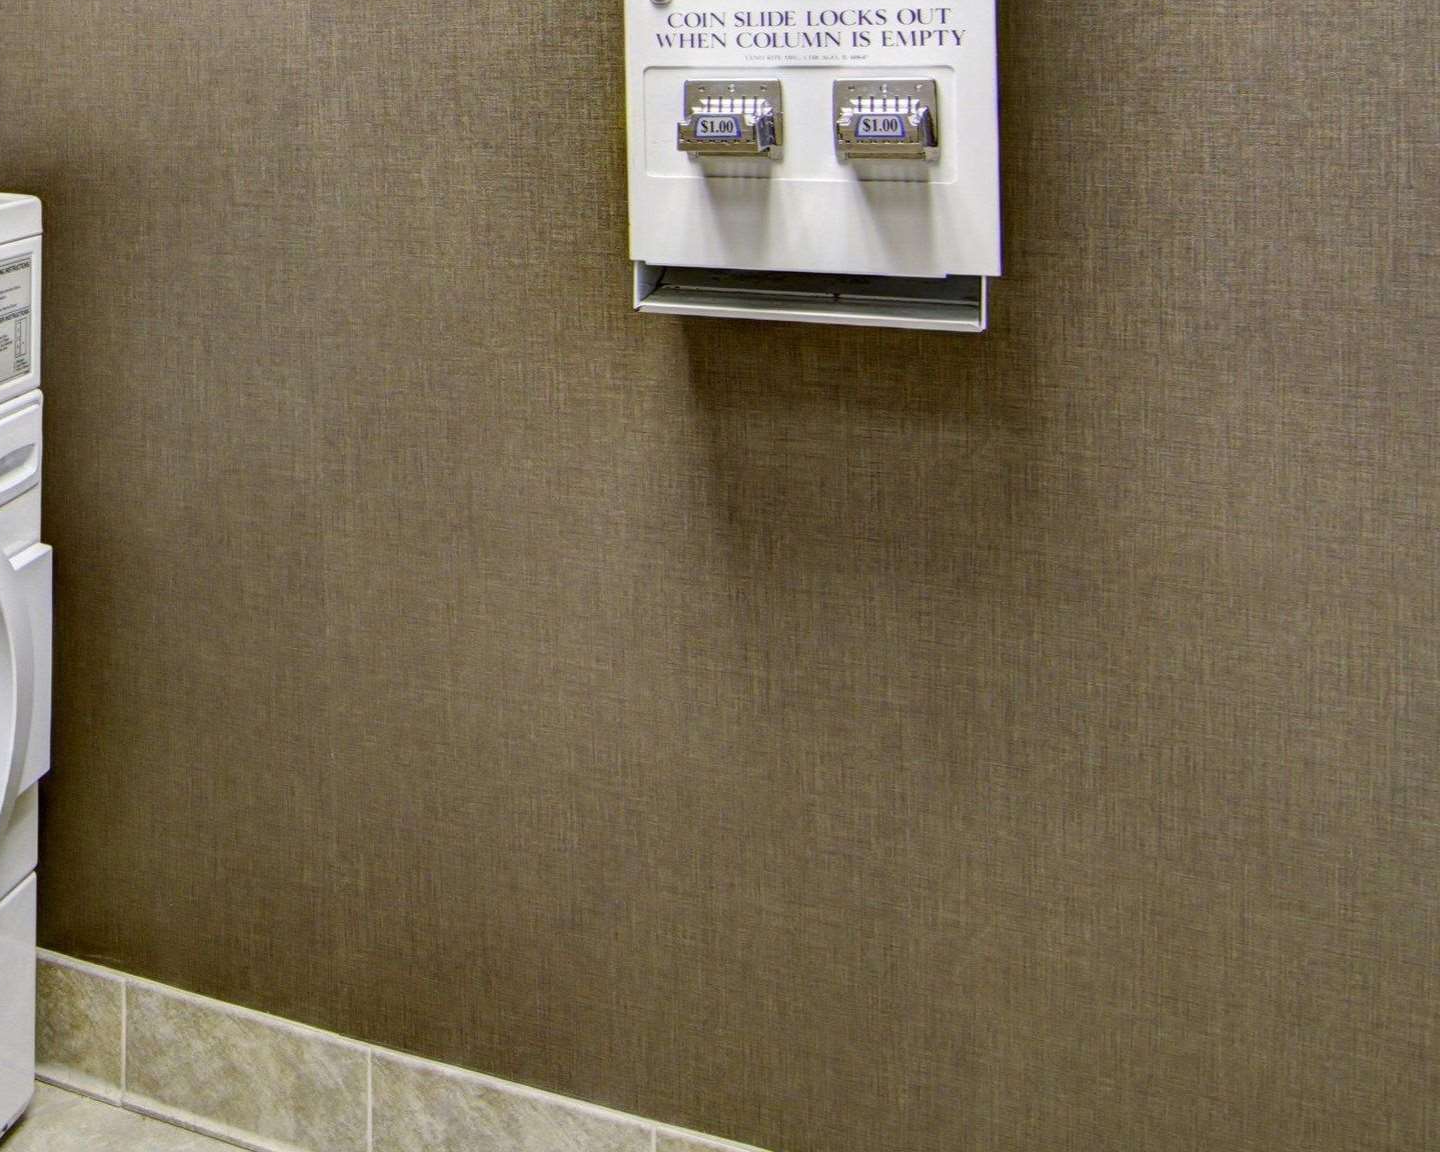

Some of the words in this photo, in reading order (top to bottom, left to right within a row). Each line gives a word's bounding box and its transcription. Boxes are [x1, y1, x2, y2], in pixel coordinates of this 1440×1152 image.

[668, 11, 726, 28] COIN
[734, 10, 796, 27] SLIDE
[806, 9, 887, 26] LOCKS
[897, 8, 951, 24] OUT
[656, 32, 727, 49] WHEN
[736, 31, 841, 48] COLUMN
[852, 31, 870, 47] IS
[882, 29, 966, 46] EMPTY
[700, 118, 734, 134] $1.00
[862, 117, 898, 133] $1.00
